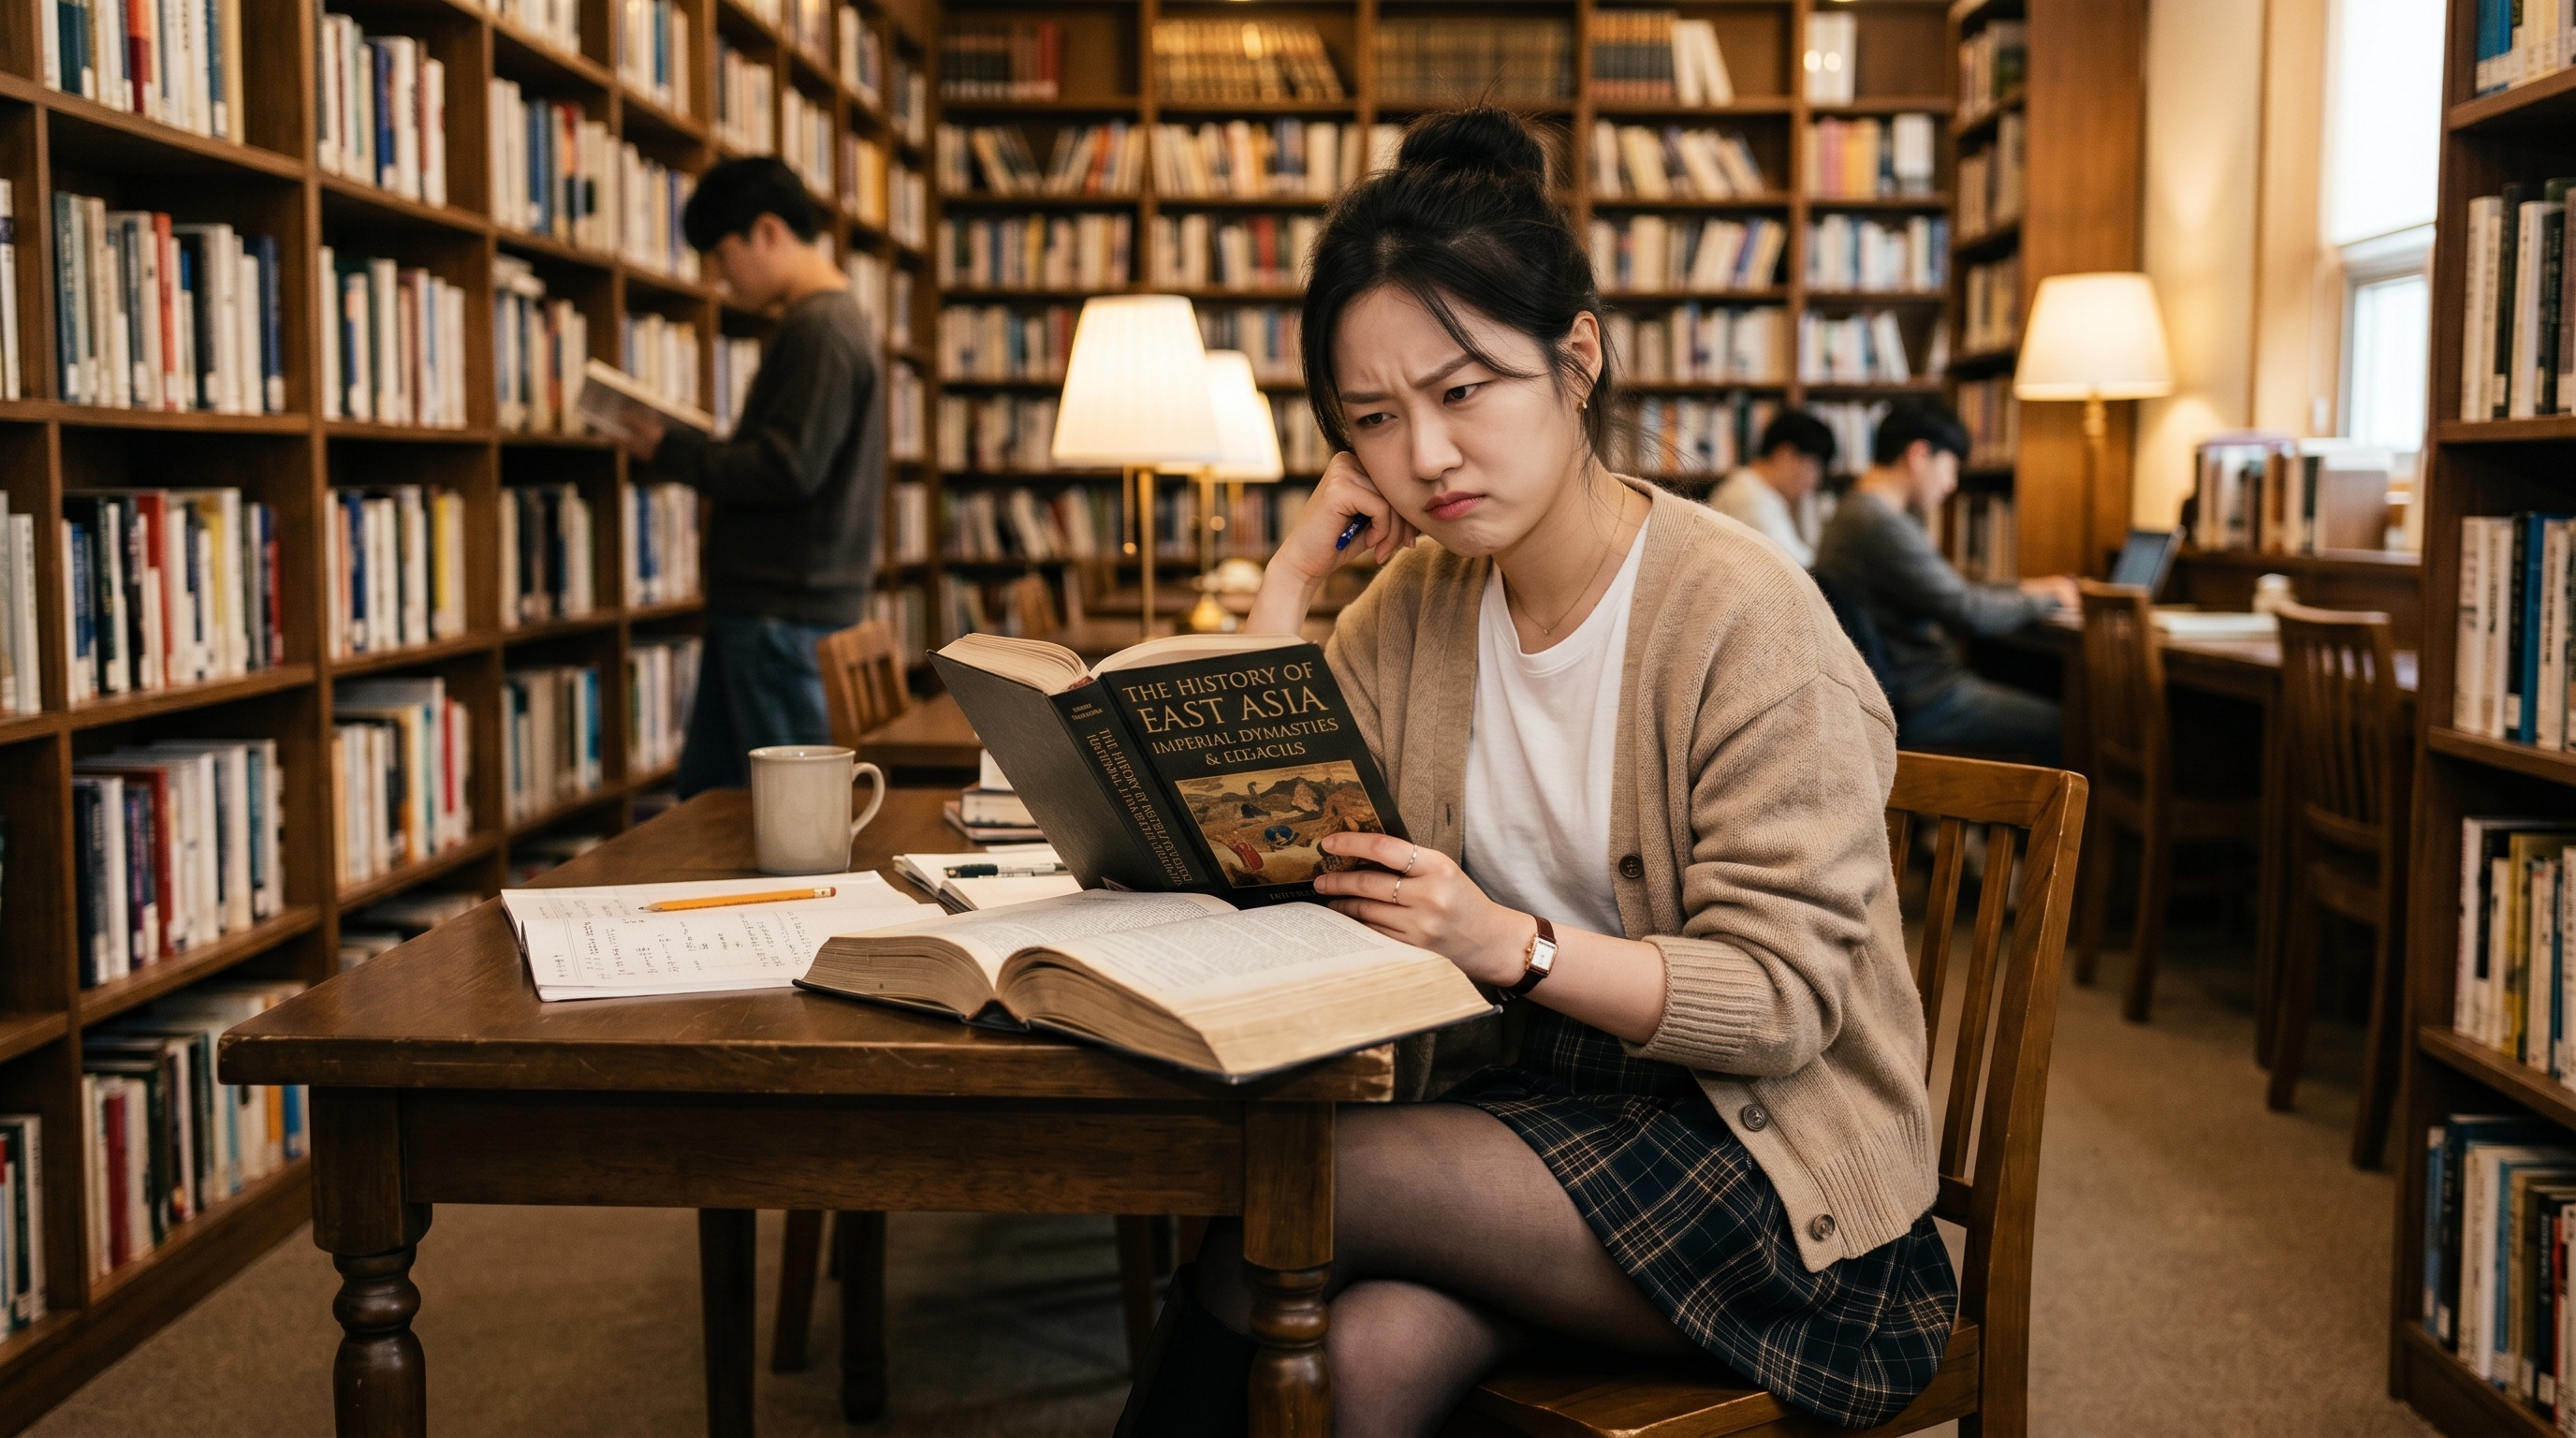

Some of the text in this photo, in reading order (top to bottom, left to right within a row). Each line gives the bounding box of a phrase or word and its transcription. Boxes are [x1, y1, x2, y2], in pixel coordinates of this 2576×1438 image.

[1122, 661, 1314, 703] THE HISTORY OF
[1136, 685, 1329, 735] EAST ASIA
[1099, 727, 1119, 751] THE
[1151, 717, 1339, 755] IMPERIAL DYMASTIES
[1205, 753, 1222, 766] &
